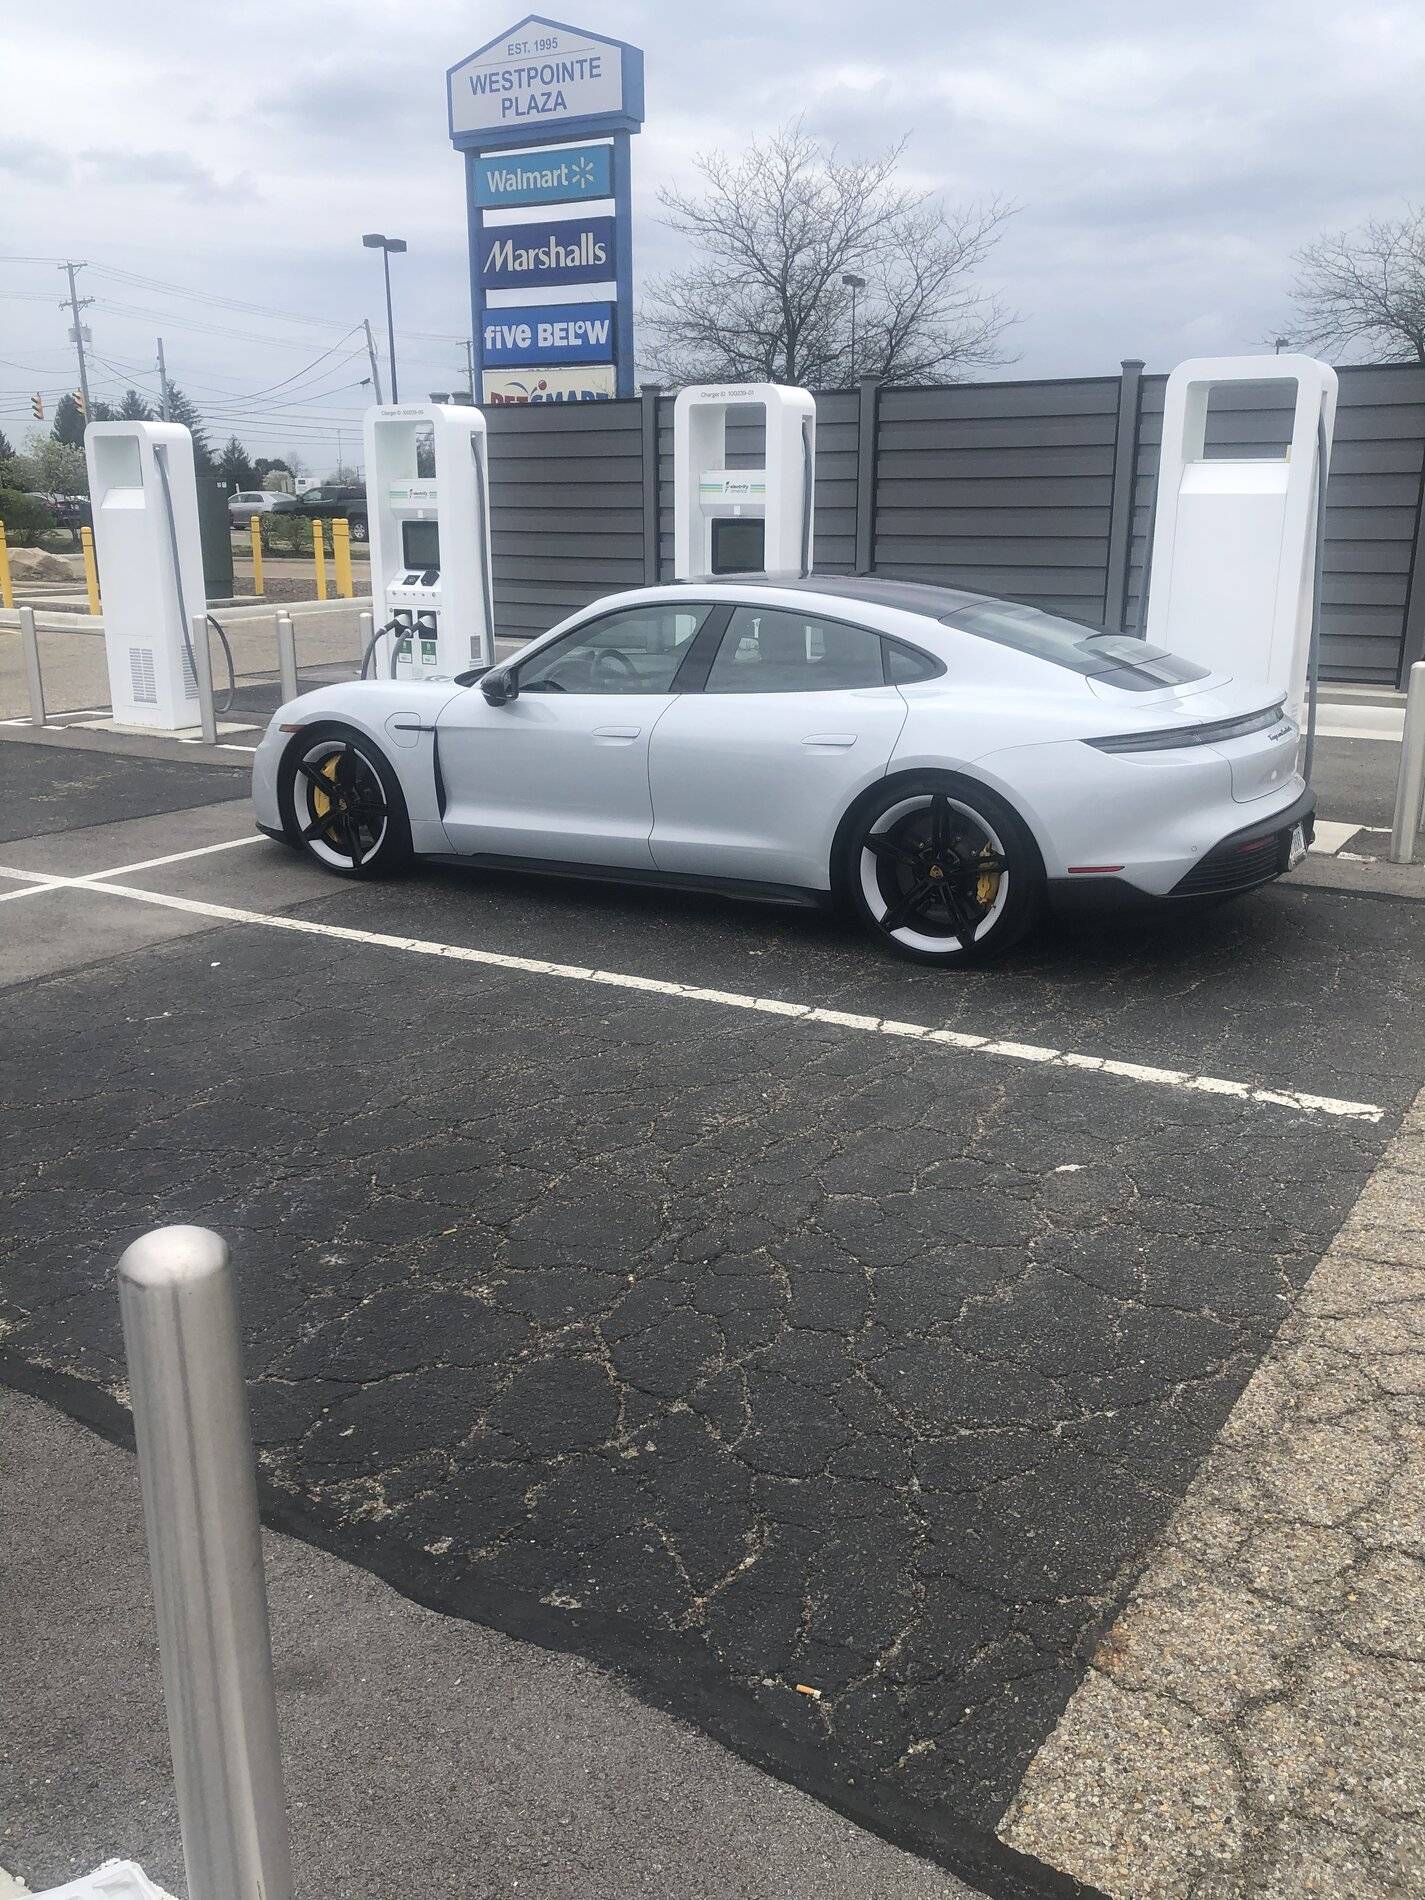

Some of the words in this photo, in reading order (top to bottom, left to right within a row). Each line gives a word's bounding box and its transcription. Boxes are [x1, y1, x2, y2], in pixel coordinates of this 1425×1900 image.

[507, 41, 530, 56] EST.
[534, 37, 558, 51] 1995
[469, 57, 602, 96] WESTPOINTE
[501, 90, 568, 119] PLAZA
[487, 163, 569, 193] Walmart
[483, 232, 607, 273] Marshalls
[484, 324, 532, 350] five
